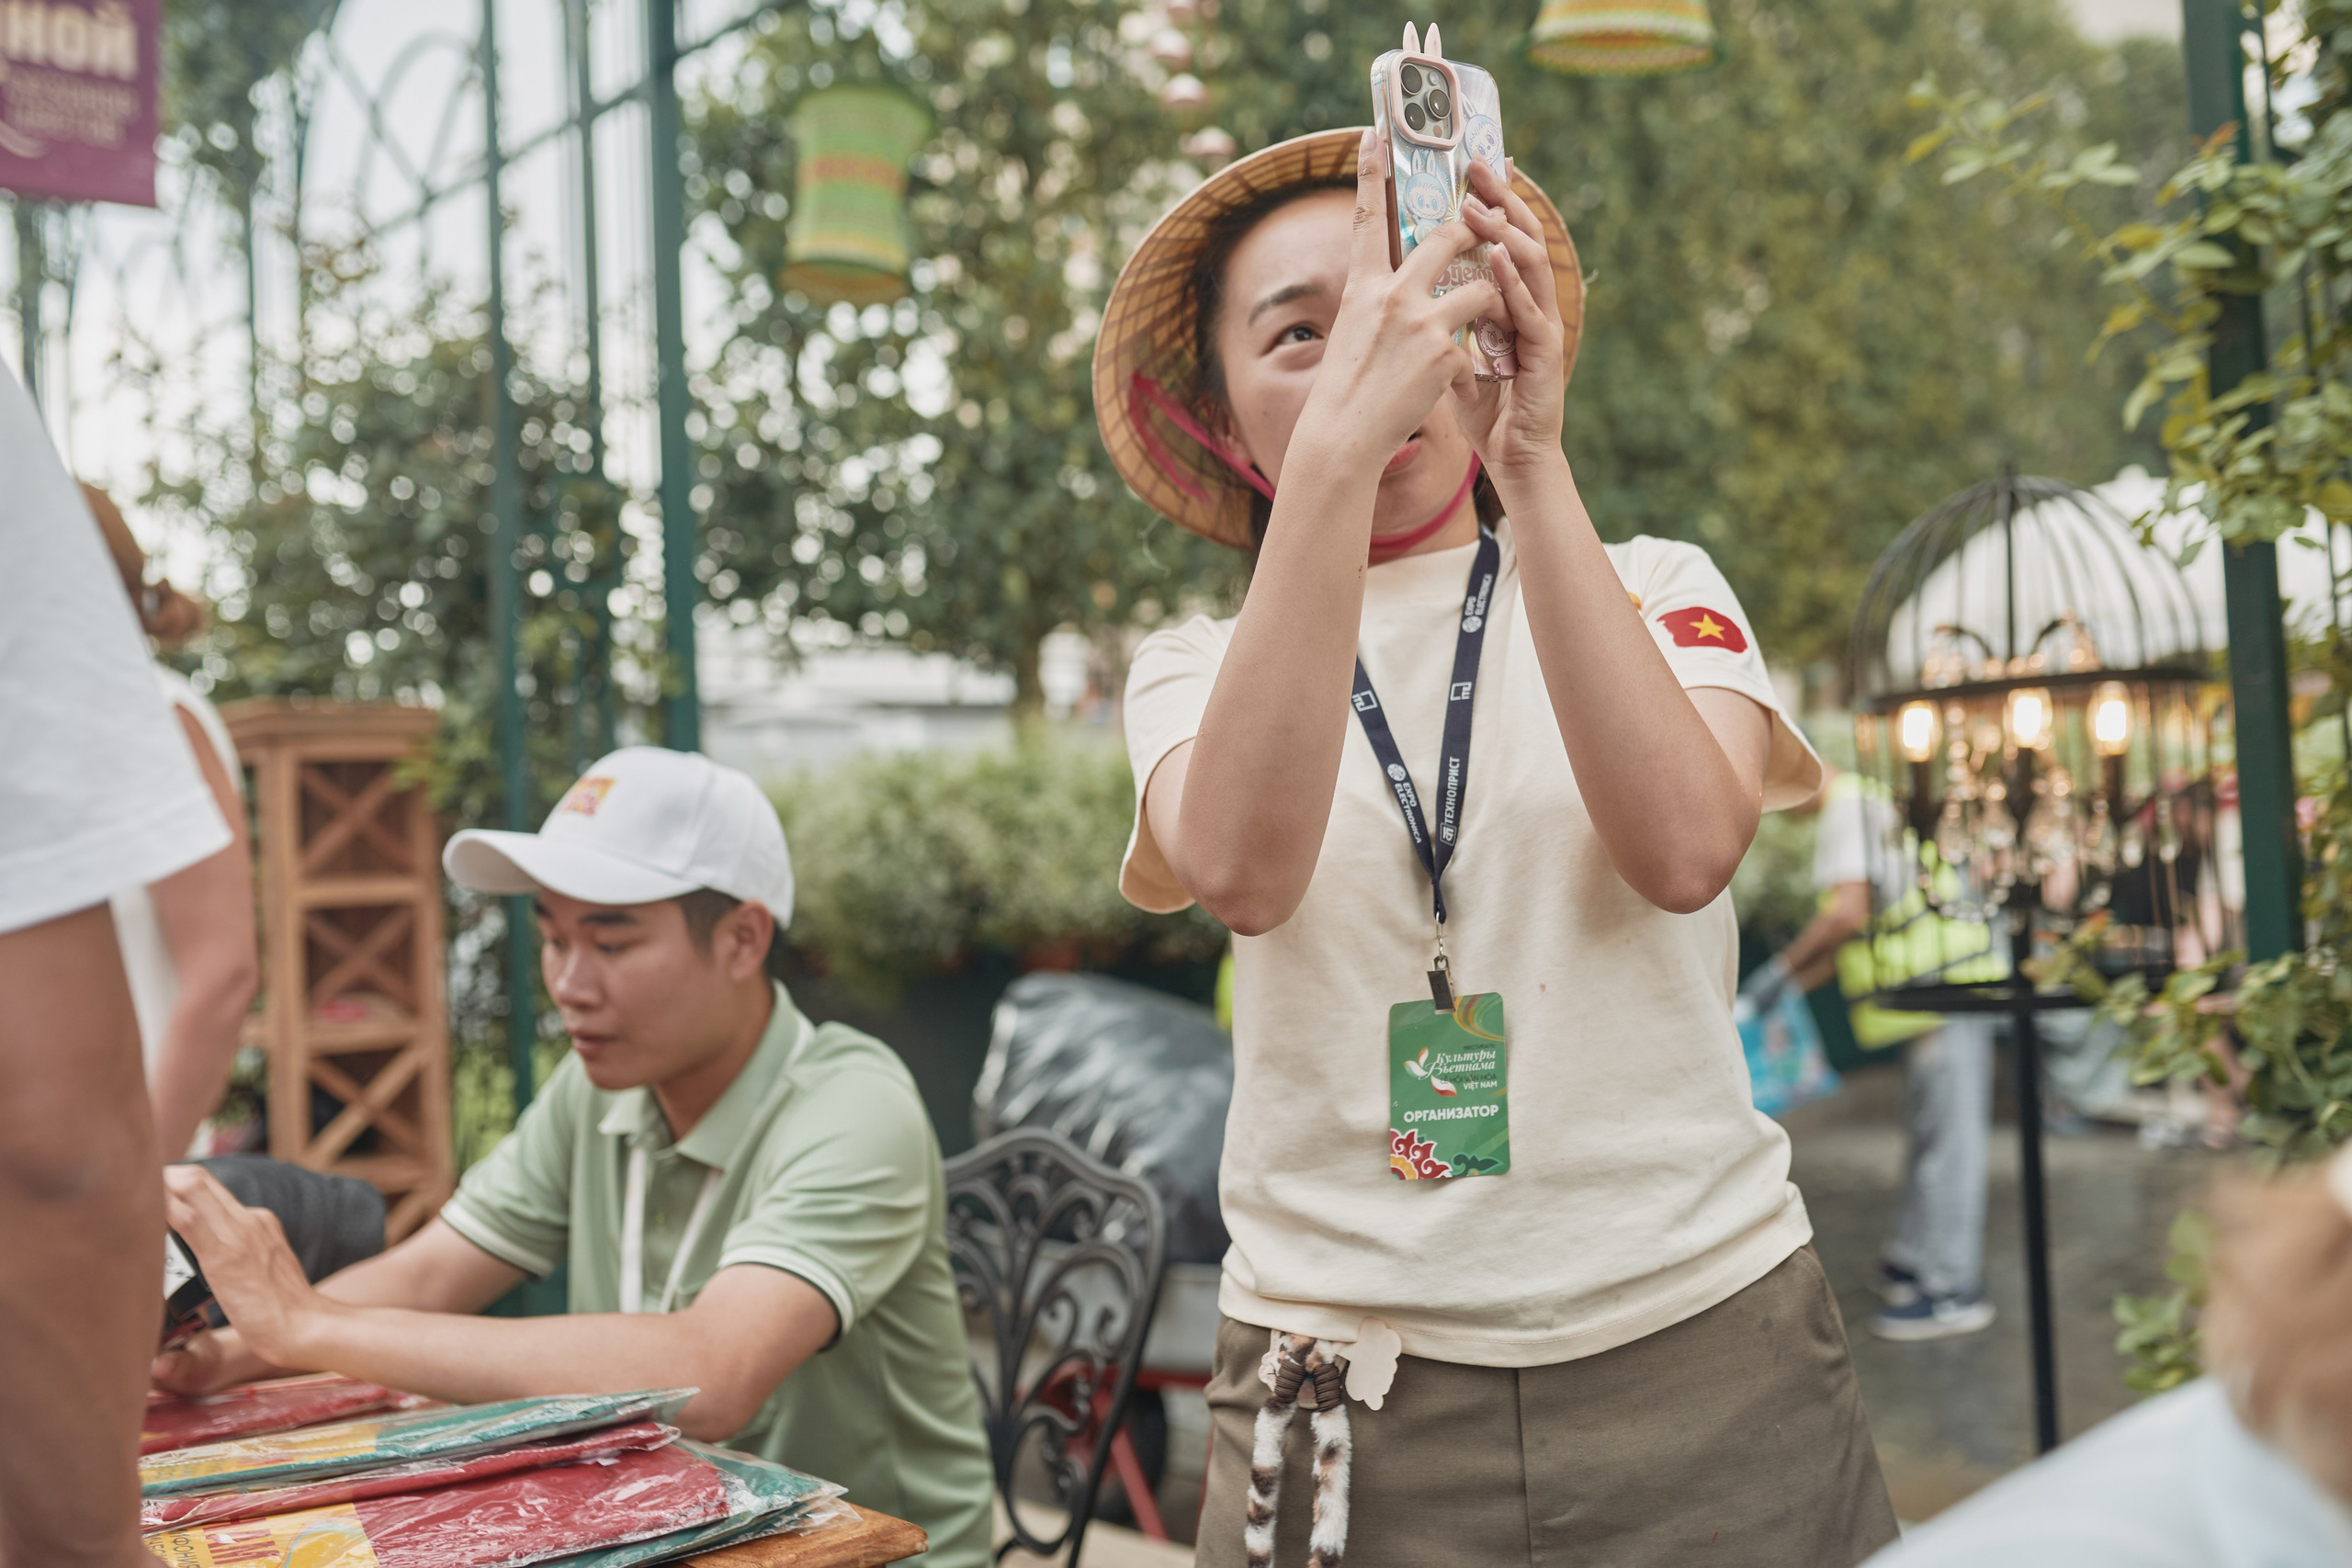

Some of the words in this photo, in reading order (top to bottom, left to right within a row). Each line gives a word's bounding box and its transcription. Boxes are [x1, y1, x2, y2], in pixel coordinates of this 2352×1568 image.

[1403, 782, 1417, 807] EXPO
[1444, 756, 1460, 825] ТЕХНОПРИСТ
[1395, 783, 1421, 844] ELECTRONICA
[1436, 1049, 1496, 1064] Культуры
[1419, 1061, 1496, 1080] Вьетнама
[1480, 1080, 1498, 1089] NAM
[1403, 1104, 1498, 1122] ОРГАНИЗАТОР
